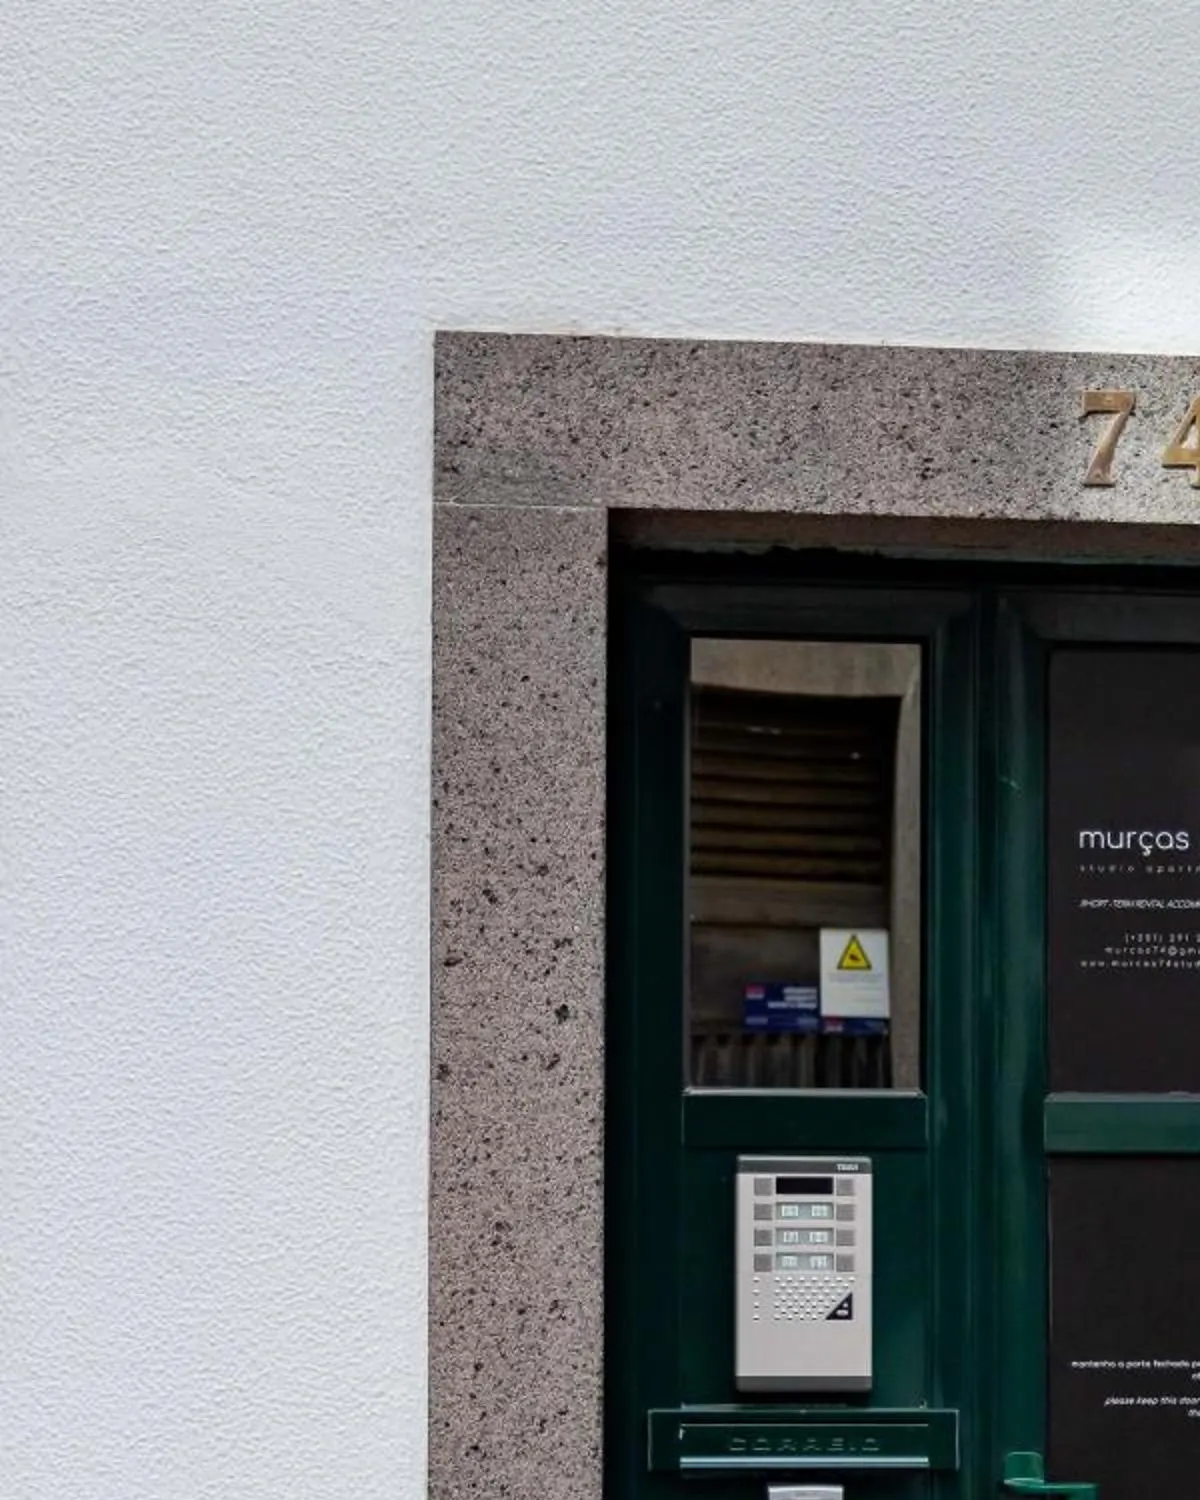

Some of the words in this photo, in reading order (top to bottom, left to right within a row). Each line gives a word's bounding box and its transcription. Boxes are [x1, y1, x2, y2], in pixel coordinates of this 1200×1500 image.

[1078, 829, 1190, 857] murças
[1079, 863, 1135, 874] studio
[1104, 1395, 1135, 1406] please
[1136, 1396, 1159, 1406] keep
[1160, 1396, 1177, 1406] this
[1179, 1396, 1200, 1406] door
